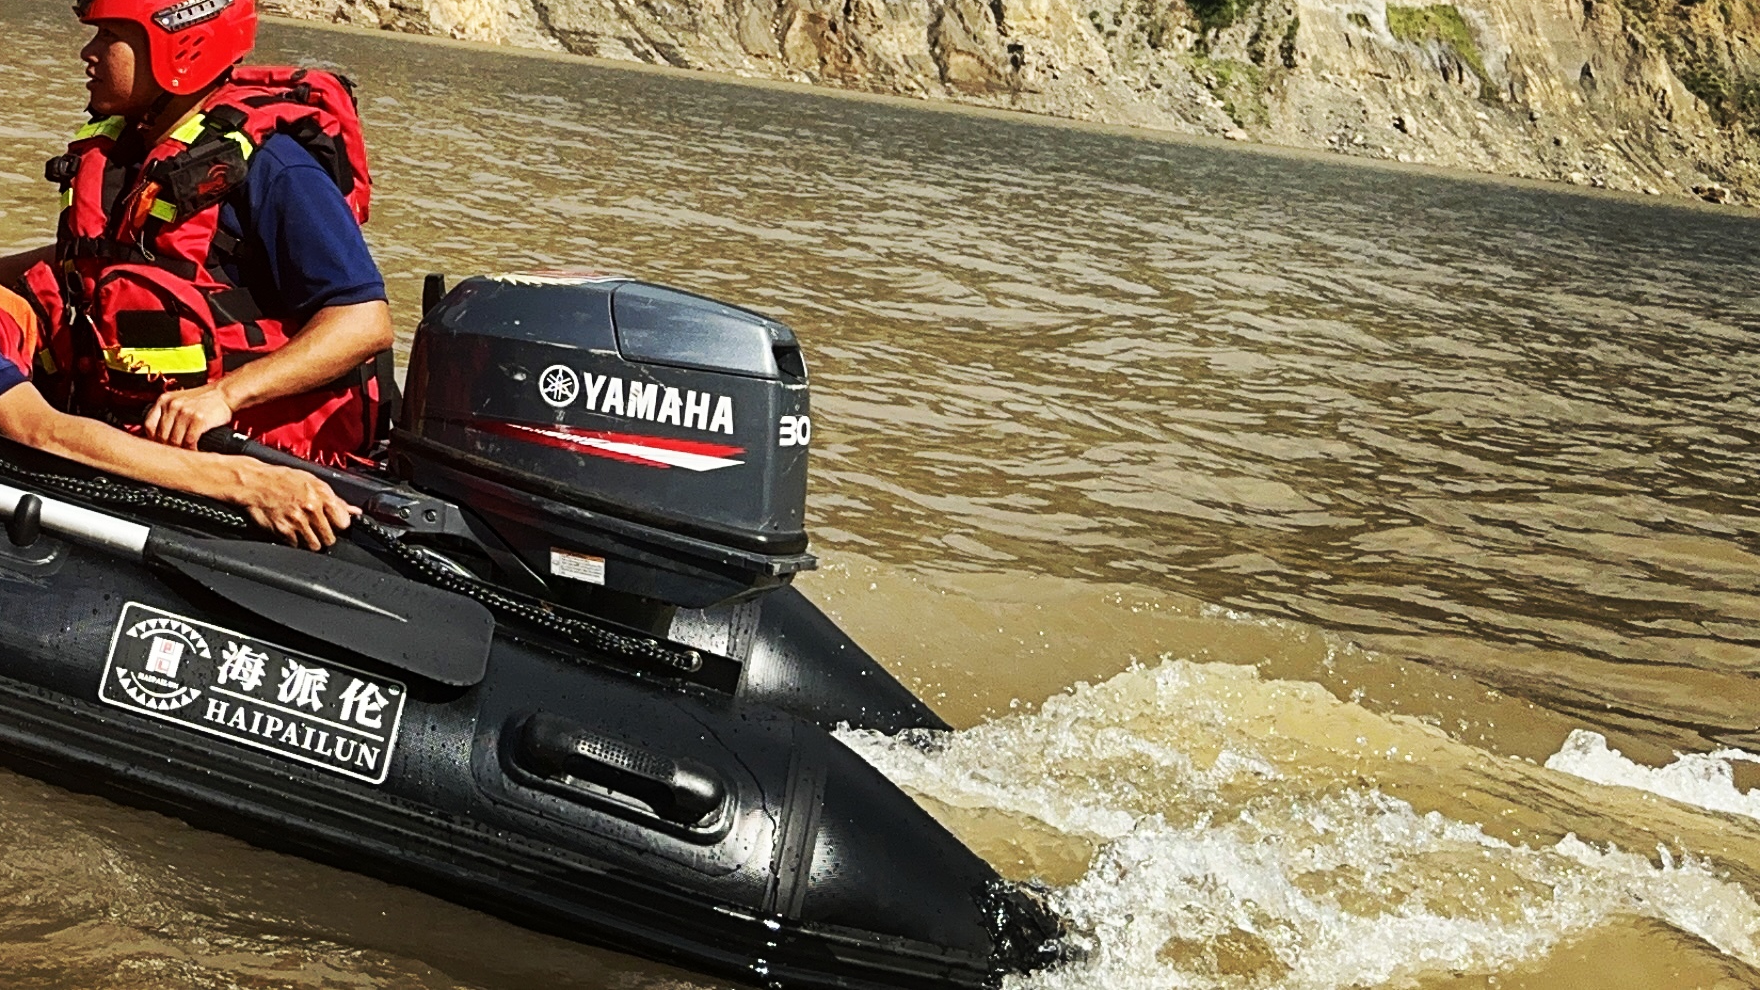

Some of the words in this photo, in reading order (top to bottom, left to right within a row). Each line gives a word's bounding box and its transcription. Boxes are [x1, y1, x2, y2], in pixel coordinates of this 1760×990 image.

[583, 372, 734, 435] YAMAHA
[779, 415, 811, 447] 30
[217, 640, 389, 729] 海派伦
[203, 697, 381, 770] HAIPAILUN
